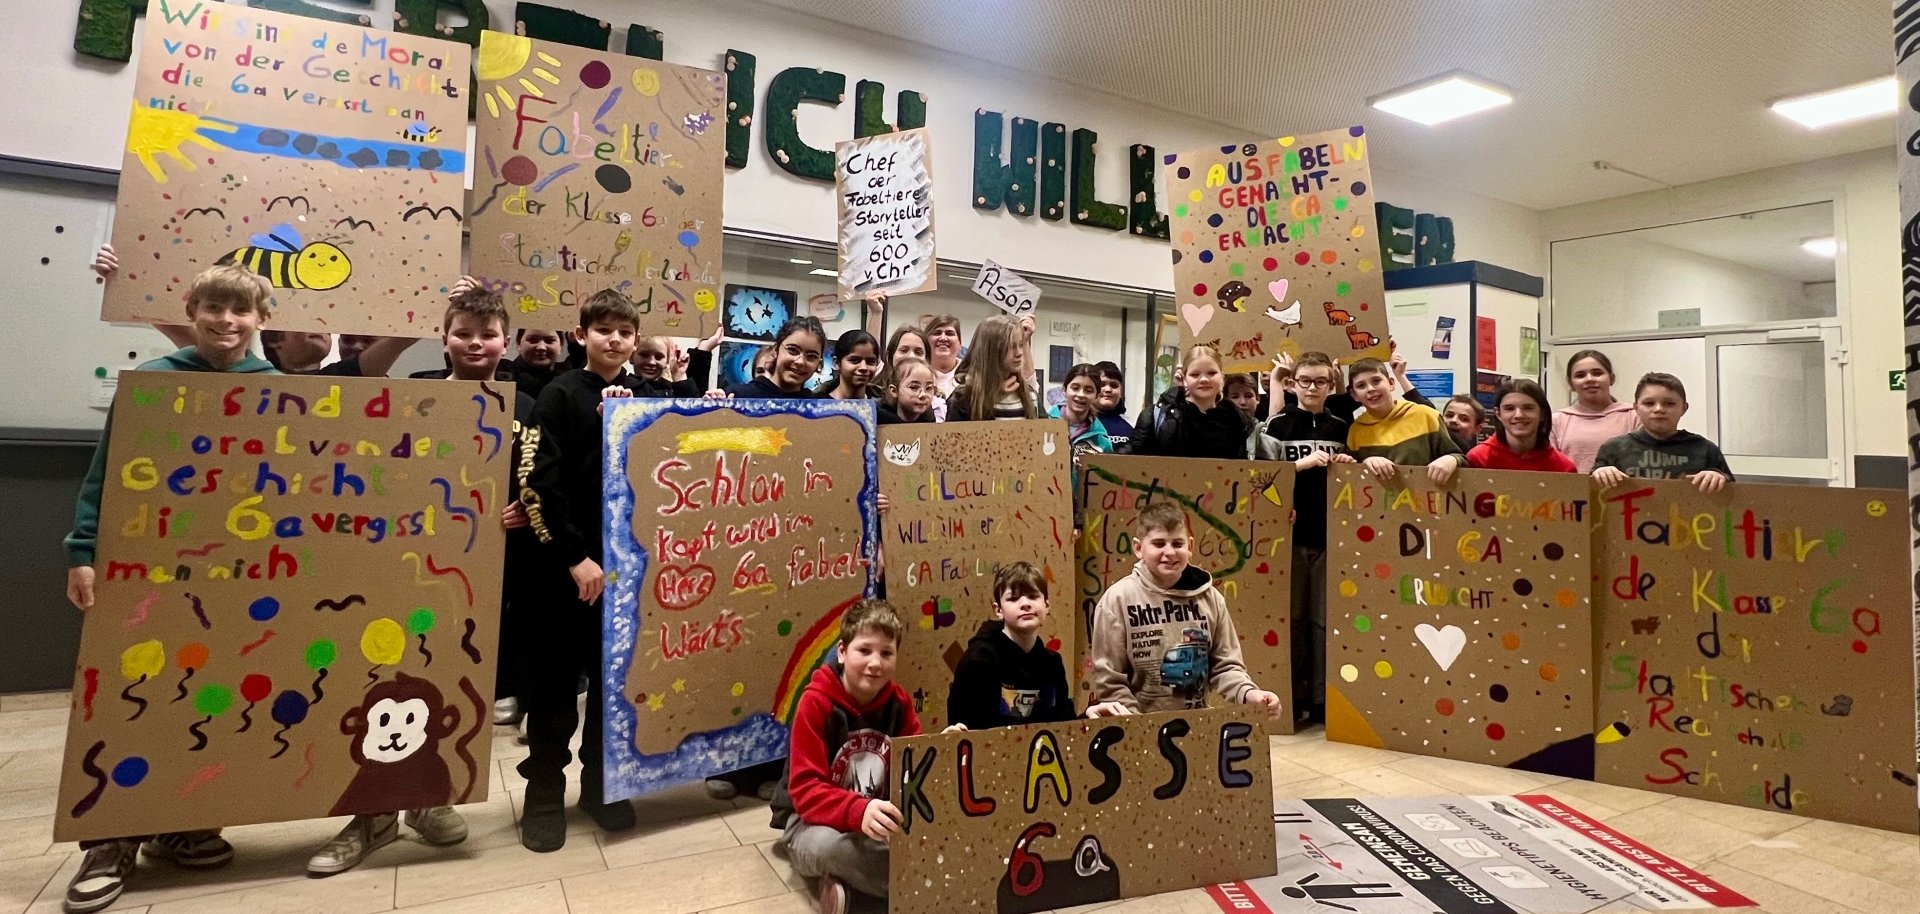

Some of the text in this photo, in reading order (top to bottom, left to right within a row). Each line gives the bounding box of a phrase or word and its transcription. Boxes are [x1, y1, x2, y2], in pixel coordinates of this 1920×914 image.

[163, 39, 217, 60] von
[235, 45, 285, 71] der
[162, 63, 203, 87] die
[231, 73, 266, 96] 6a
[846, 152, 898, 175] Chef
[1206, 158, 1263, 188] AUS
[502, 186, 546, 216] der
[845, 189, 921, 207] Fabeltiere
[854, 205, 930, 226] Storyteller
[873, 223, 904, 241] seit
[868, 242, 909, 263] 600
[222, 385, 341, 418] sind
[1638, 449, 1689, 468] JUMP
[654, 450, 786, 516] Schlau
[225, 494, 304, 540] 6a
[1244, 520, 1285, 560] der
[733, 550, 772, 590] 6a
[906, 560, 933, 587] 6A
[1612, 555, 1658, 601] de
[1131, 629, 1164, 640] EXPLORE
[1132, 639, 1161, 650] NATURE
[1133, 650, 1151, 659] NOW
[901, 718, 1253, 835] KLASSE
[1538, 802, 1594, 833] HALTEN
[1009, 821, 1111, 896] 6a
[1341, 822, 1431, 881] GEMEINSAM
[1570, 848, 1617, 873] ABSTAND
[1591, 829, 1667, 868] ABSTAND
[1416, 855, 1449, 876] DAS
[1501, 839, 1608, 901] HYGIENETIPPS
[1659, 867, 1718, 894] BITTE
[1440, 874, 1495, 906] GEGEN
